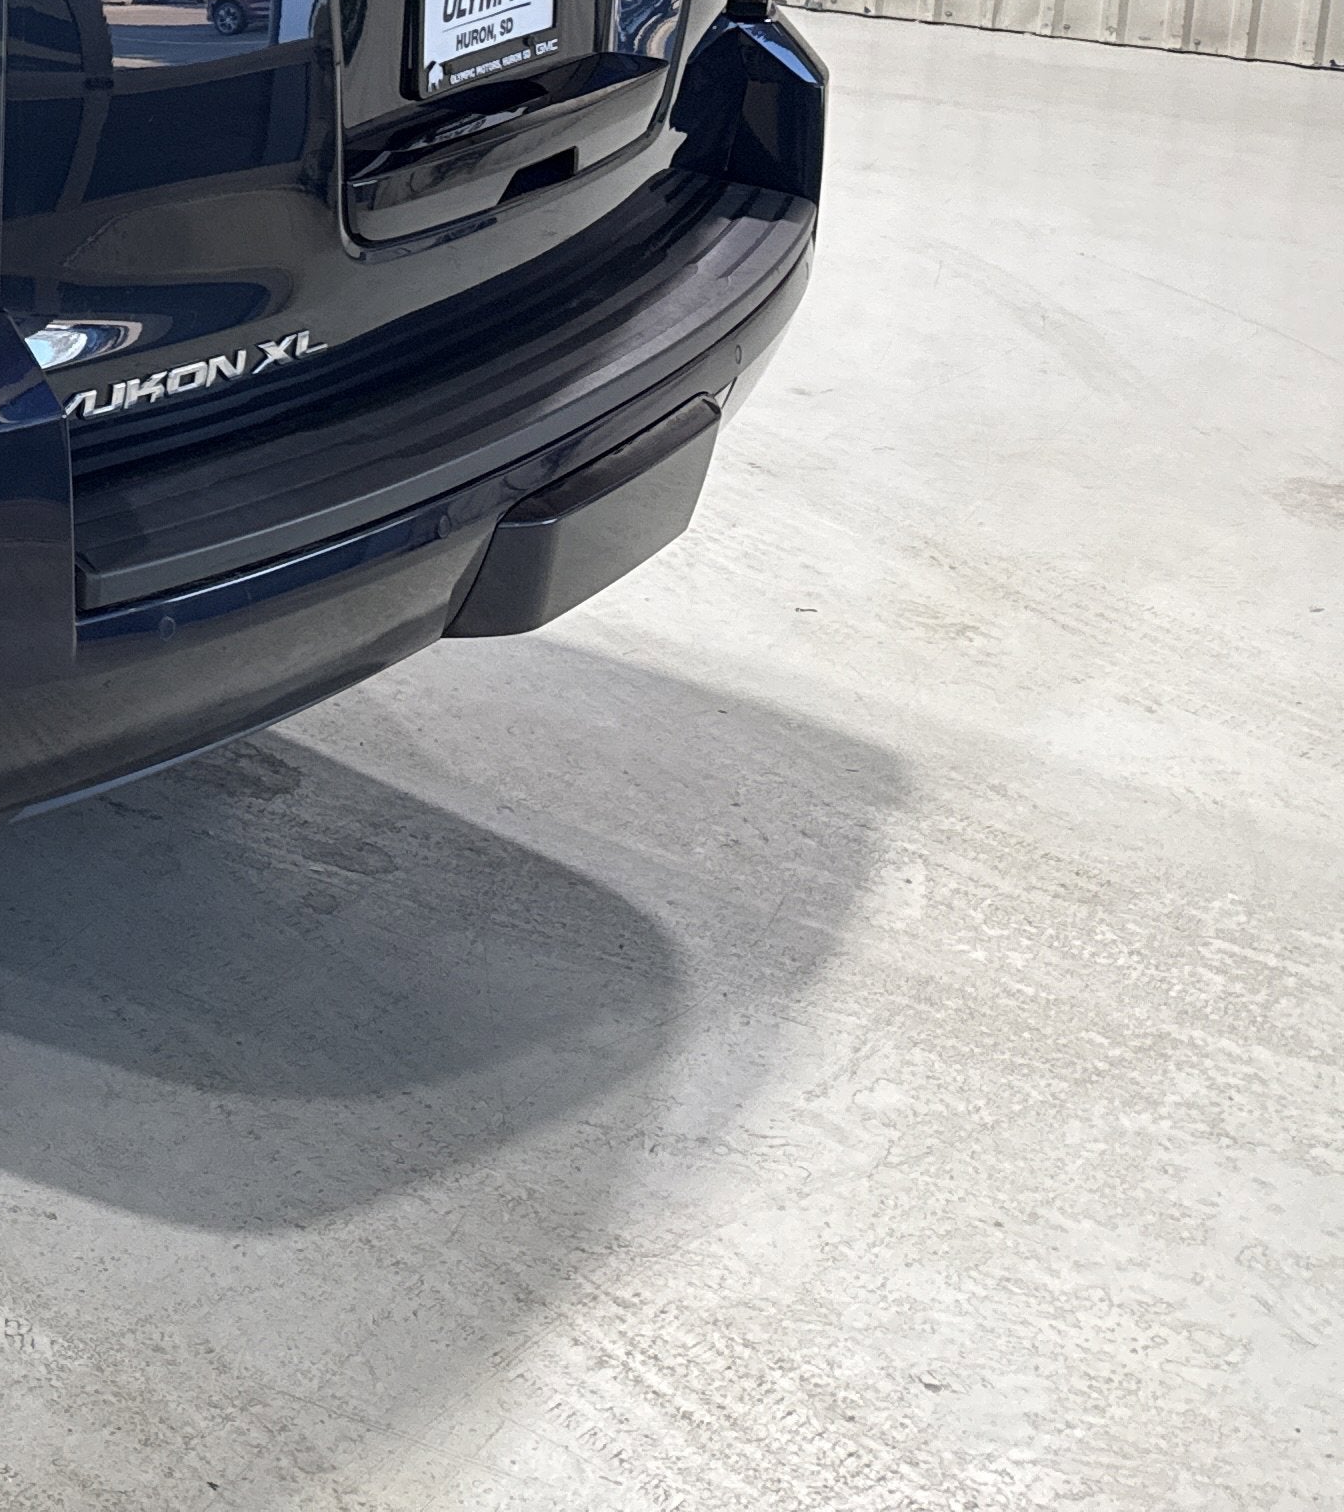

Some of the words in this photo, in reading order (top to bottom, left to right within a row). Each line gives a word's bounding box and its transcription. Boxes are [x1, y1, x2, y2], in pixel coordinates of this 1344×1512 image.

[456, 23, 497, 51] HURON,
[499, 17, 513, 36] SD
[535, 39, 558, 56] GMC
[253, 330, 328, 375] XL
